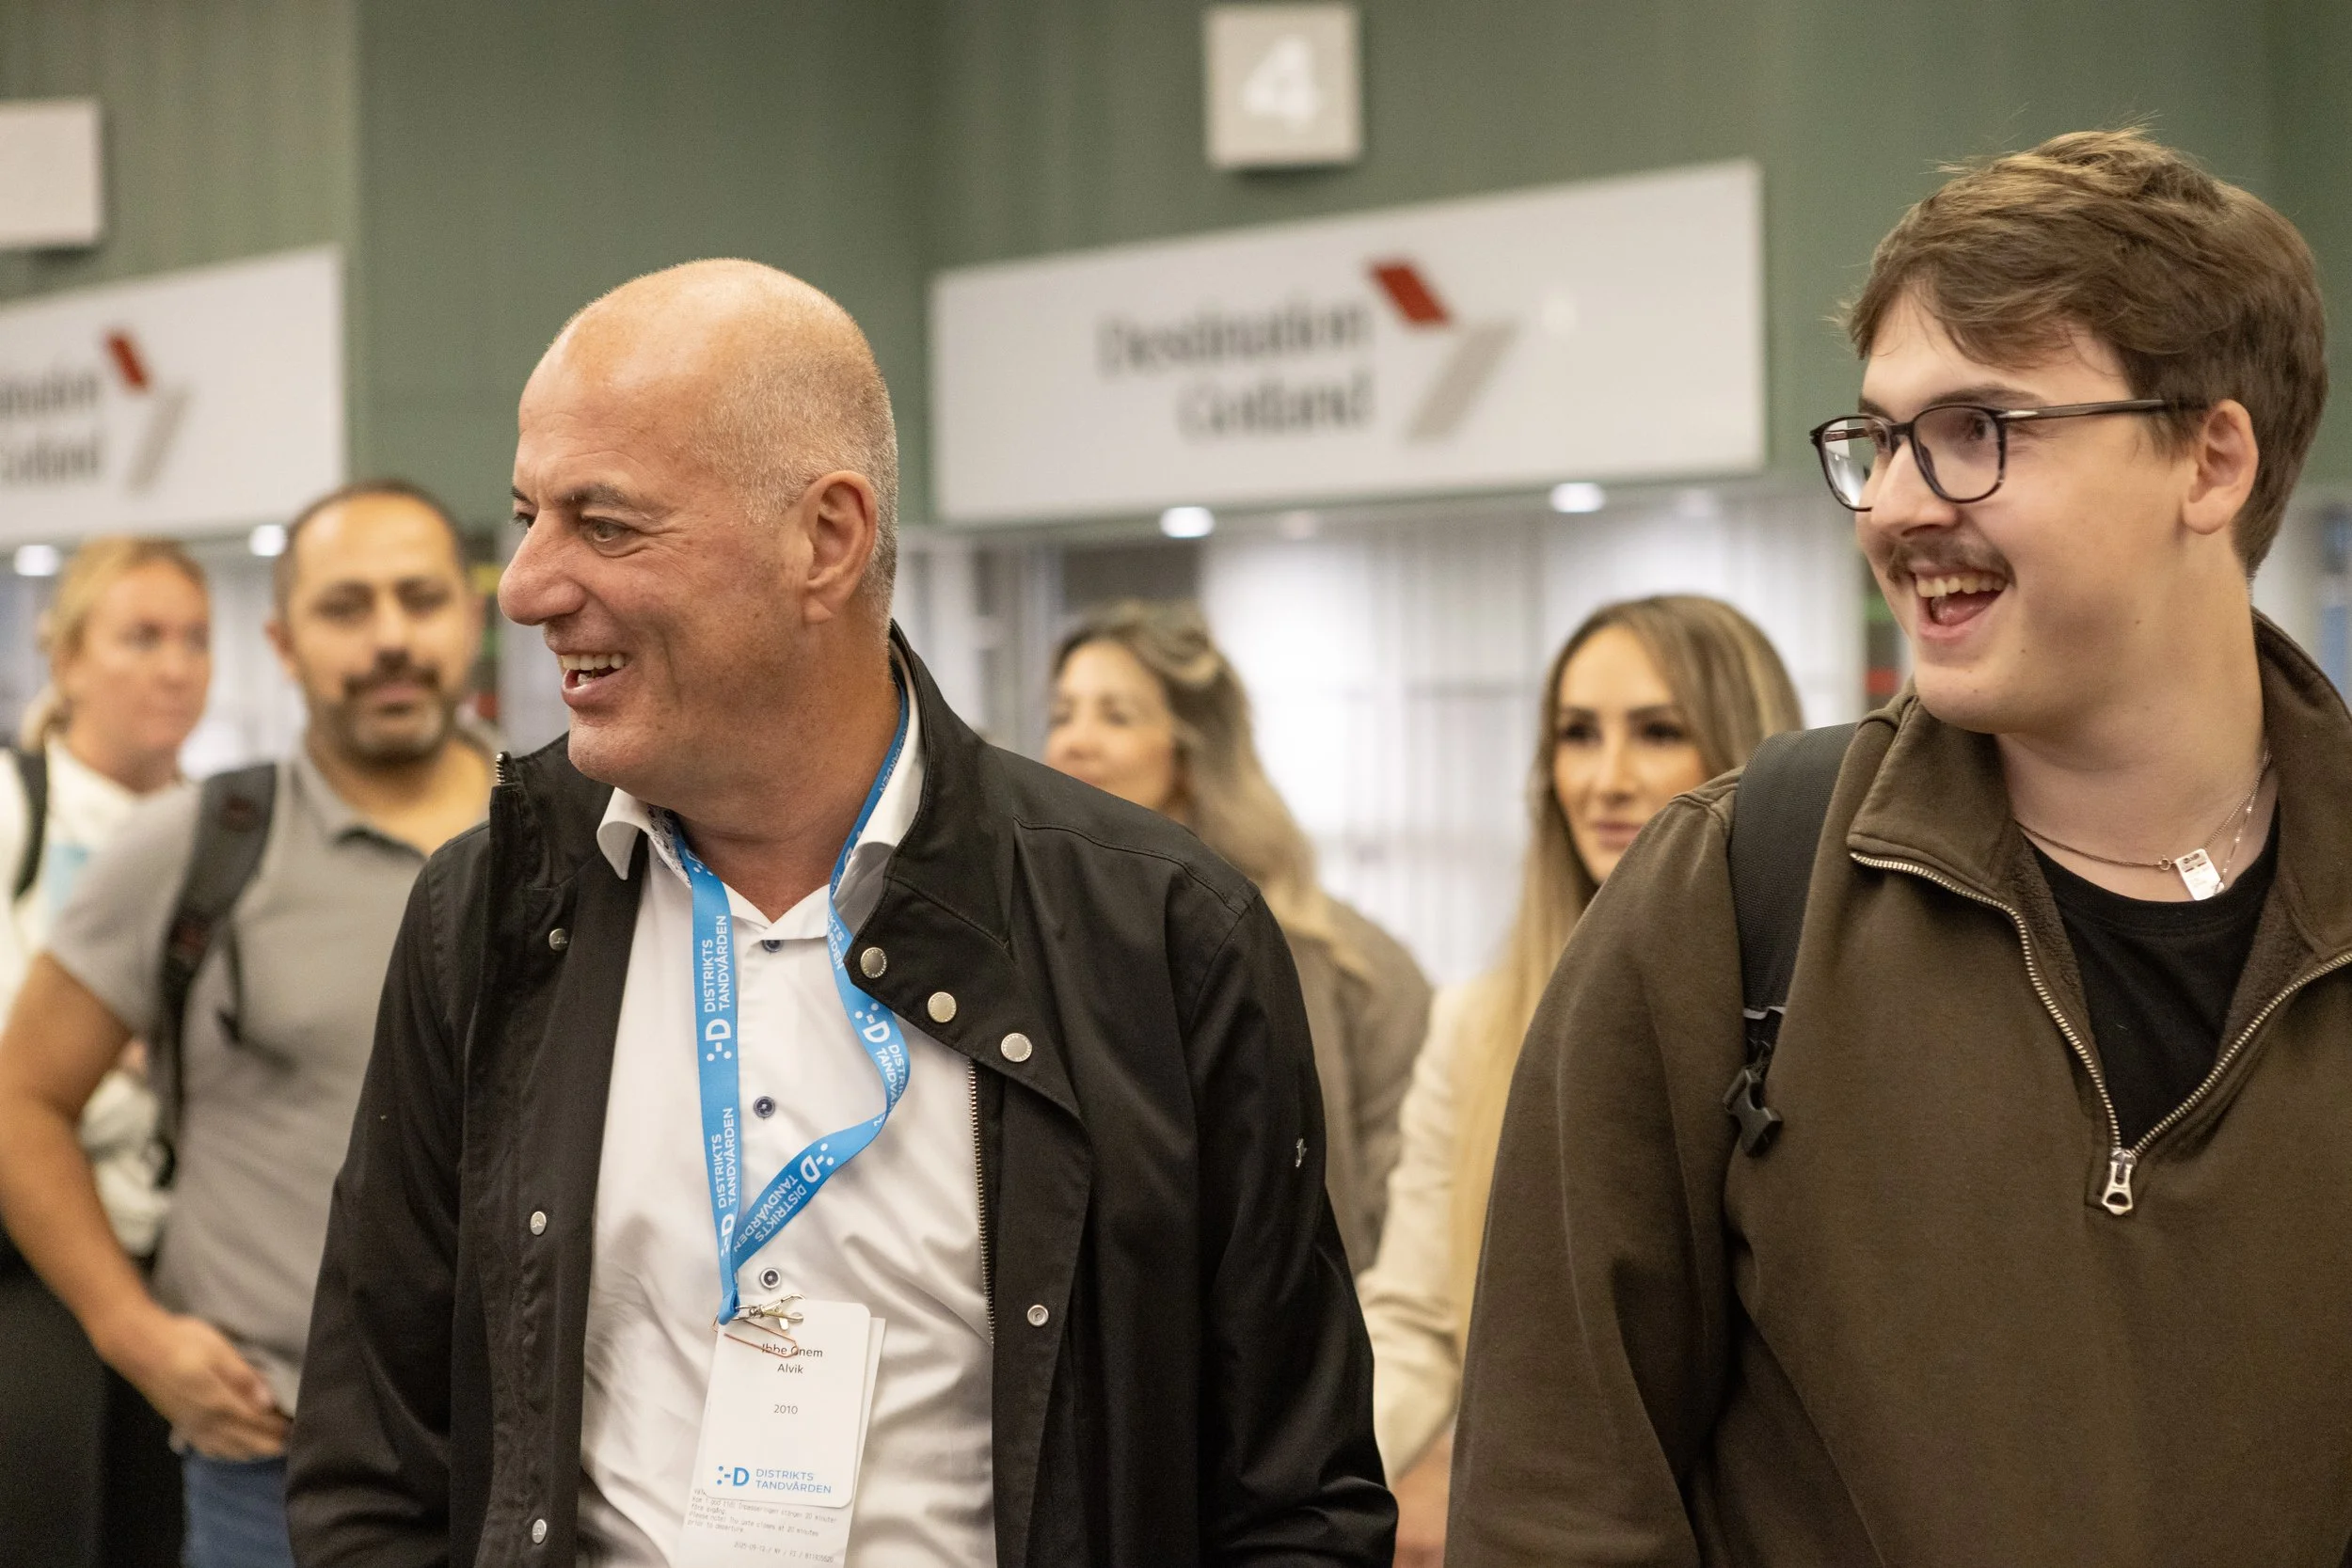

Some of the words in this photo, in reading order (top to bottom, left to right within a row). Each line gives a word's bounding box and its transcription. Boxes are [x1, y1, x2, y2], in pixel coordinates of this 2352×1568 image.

[1243, 35, 1319, 128] 4
[702, 939, 716, 1013] DISTRIKTS
[714, 915, 731, 1011] TANDVÅRDEN
[711, 1133, 727, 1210] DISTRIKTS
[723, 1107, 737, 1206] TANDVÅRDEN
[733, 1174, 799, 1252] TANDVÅRDEN
[755, 1184, 807, 1243] DISTRIKTS
[777, 1363, 803, 1374] Alvik
[773, 1403, 799, 1415] 2010
[755, 1468, 815, 1481] DISTRIKTS
[755, 1480, 832, 1494] TANDVÅRDEN
